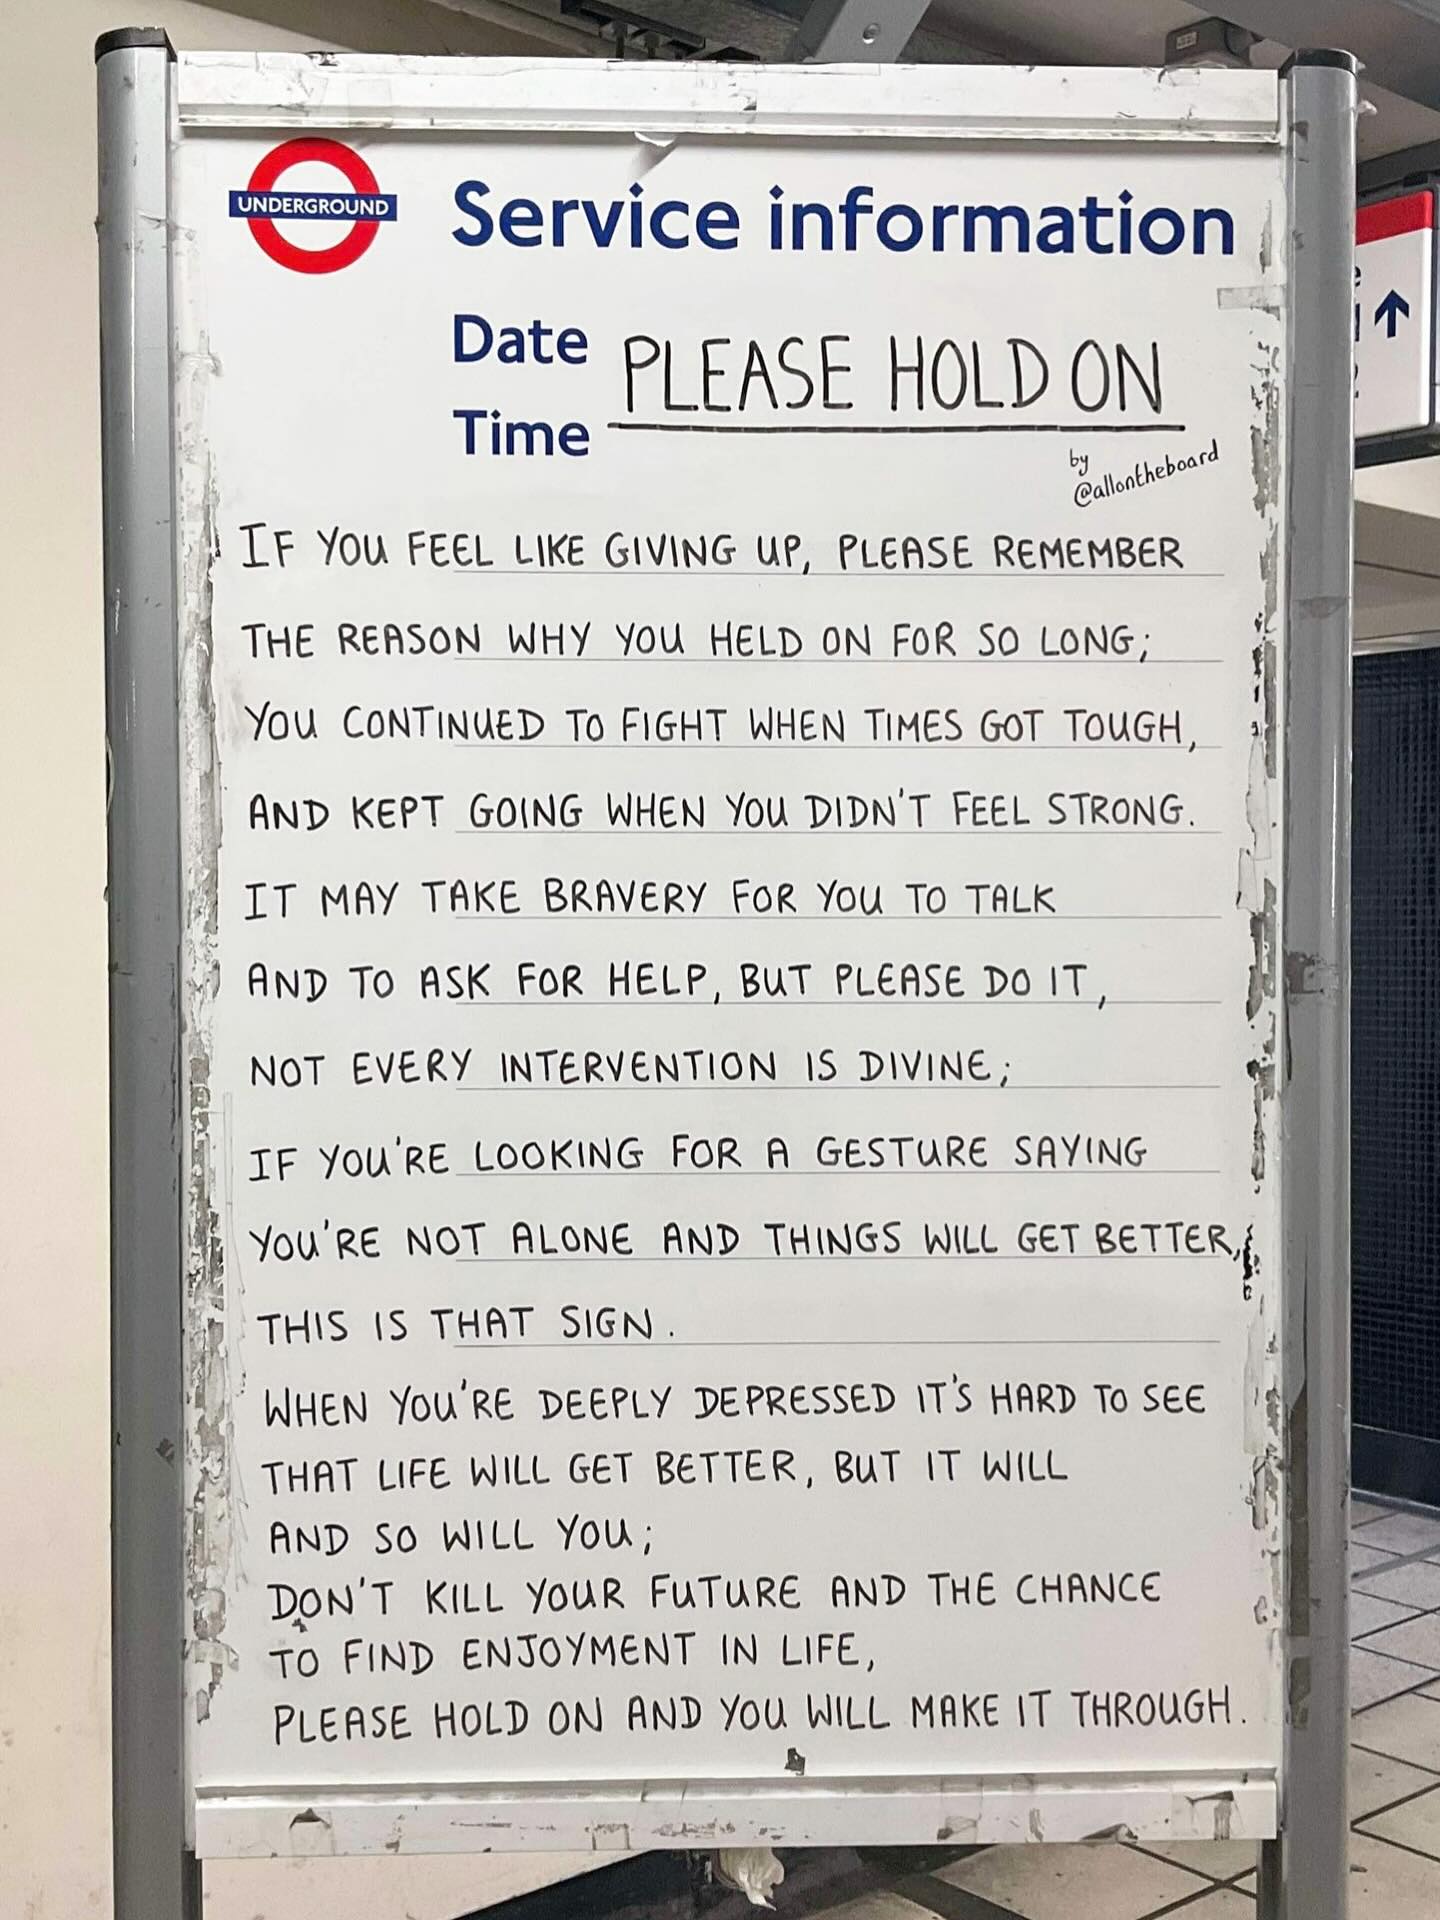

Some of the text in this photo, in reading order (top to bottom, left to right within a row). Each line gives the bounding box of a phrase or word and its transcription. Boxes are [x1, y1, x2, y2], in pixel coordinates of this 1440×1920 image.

[237, 195, 390, 217] UNDERGROUND
[451, 179, 1234, 256] Service information
[453, 313, 589, 365] Date
[623, 334, 1162, 415] PLEASE HOLD ON
[452, 408, 590, 457] Time
[1069, 448, 1089, 477] by
[1073, 438, 1219, 508] @allontheboard
[238, 522, 1184, 576] IF YOU FEEL LIKE GIVING UP, PLEASE REMEMBER
[240, 620, 1150, 664] THE REASON WHY YOU HELD ON FOR SO LONG;
[243, 700, 1196, 753] YOU CONTINUED TO FIGHT WHEN TIMES GOT TOUGH,
[249, 787, 1195, 832] AND KEPT GOING WHEN YOU DIDN'T FEEL STRONG.
[244, 877, 1056, 921] IT MAY TAKE BRAVERY FOR YOU TO TALK
[248, 960, 1106, 1011] AND TO ASK FOR HELP, BUT PLEASE DO IT,
[251, 1047, 1010, 1089] NOT EVERY INTERVENTION IS DIVINE;
[248, 1133, 1148, 1182] IF YOU'RE LOOKING FOR A GESTURE SAYING
[248, 1218, 1241, 1263] YOU'RE NOT ALONE AND THINGS WILL GET BETTER,
[256, 1304, 674, 1346] THIS IS THAT SIGN.
[265, 1372, 1206, 1428] WHEN YOU'RE DEEPLY DEPRESSED IT'S HARD TO SEE
[260, 1449, 1069, 1496] THAT LIFE WILL GET BETTER, BUT IT WILL
[270, 1513, 652, 1557] AND SO WILL YOU;
[266, 1571, 1161, 1621] DON'T KILL YOUR FUTURE AND THE CHANCE
[268, 1631, 874, 1679] TO FIND ENJOYMENT IN LIFE,
[274, 1684, 1248, 1746] PLEASE HOLD ON AND YOU WILL MAKE IT THROUGH.
